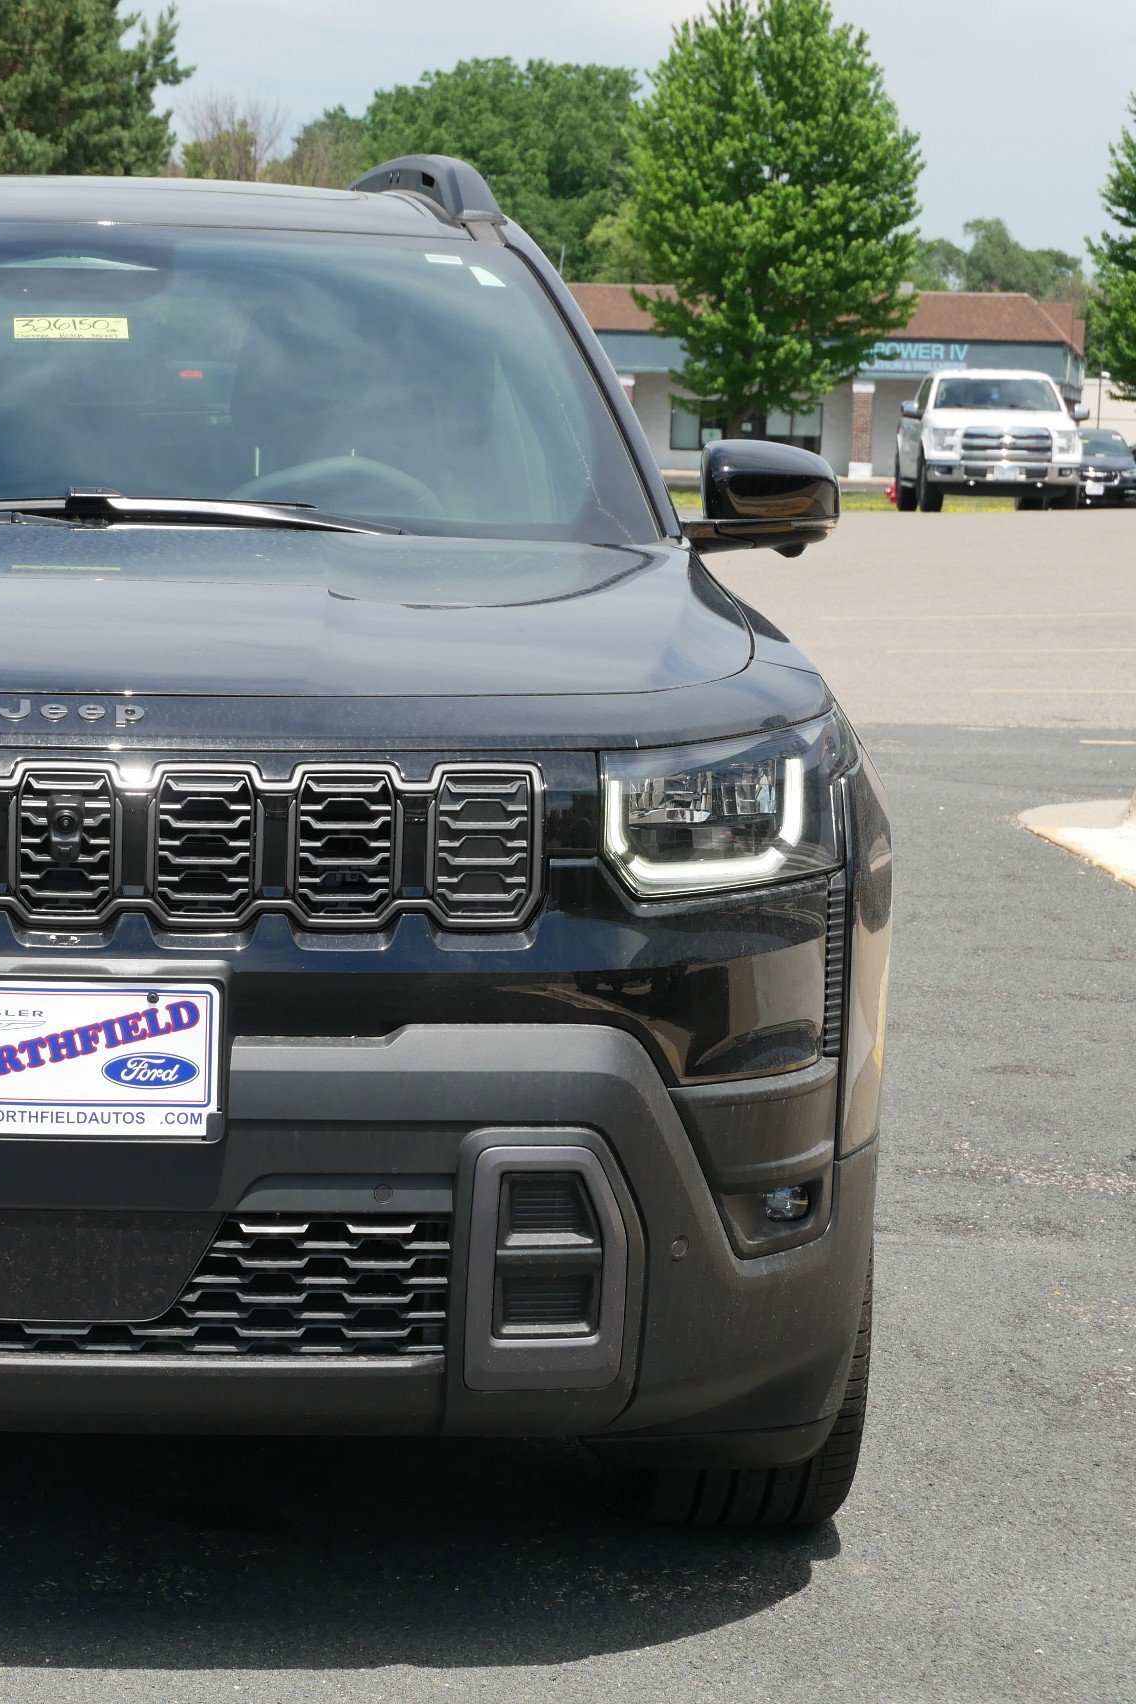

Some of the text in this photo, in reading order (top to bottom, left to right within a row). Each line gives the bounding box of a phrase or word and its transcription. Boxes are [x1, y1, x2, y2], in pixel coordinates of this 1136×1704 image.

[15, 319, 110, 333] 326150
[862, 342, 969, 360] POWER IV
[0, 699, 145, 727] Jeep
[119, 1057, 179, 1083] Ford
[159, 1112, 203, 1126] .COM
